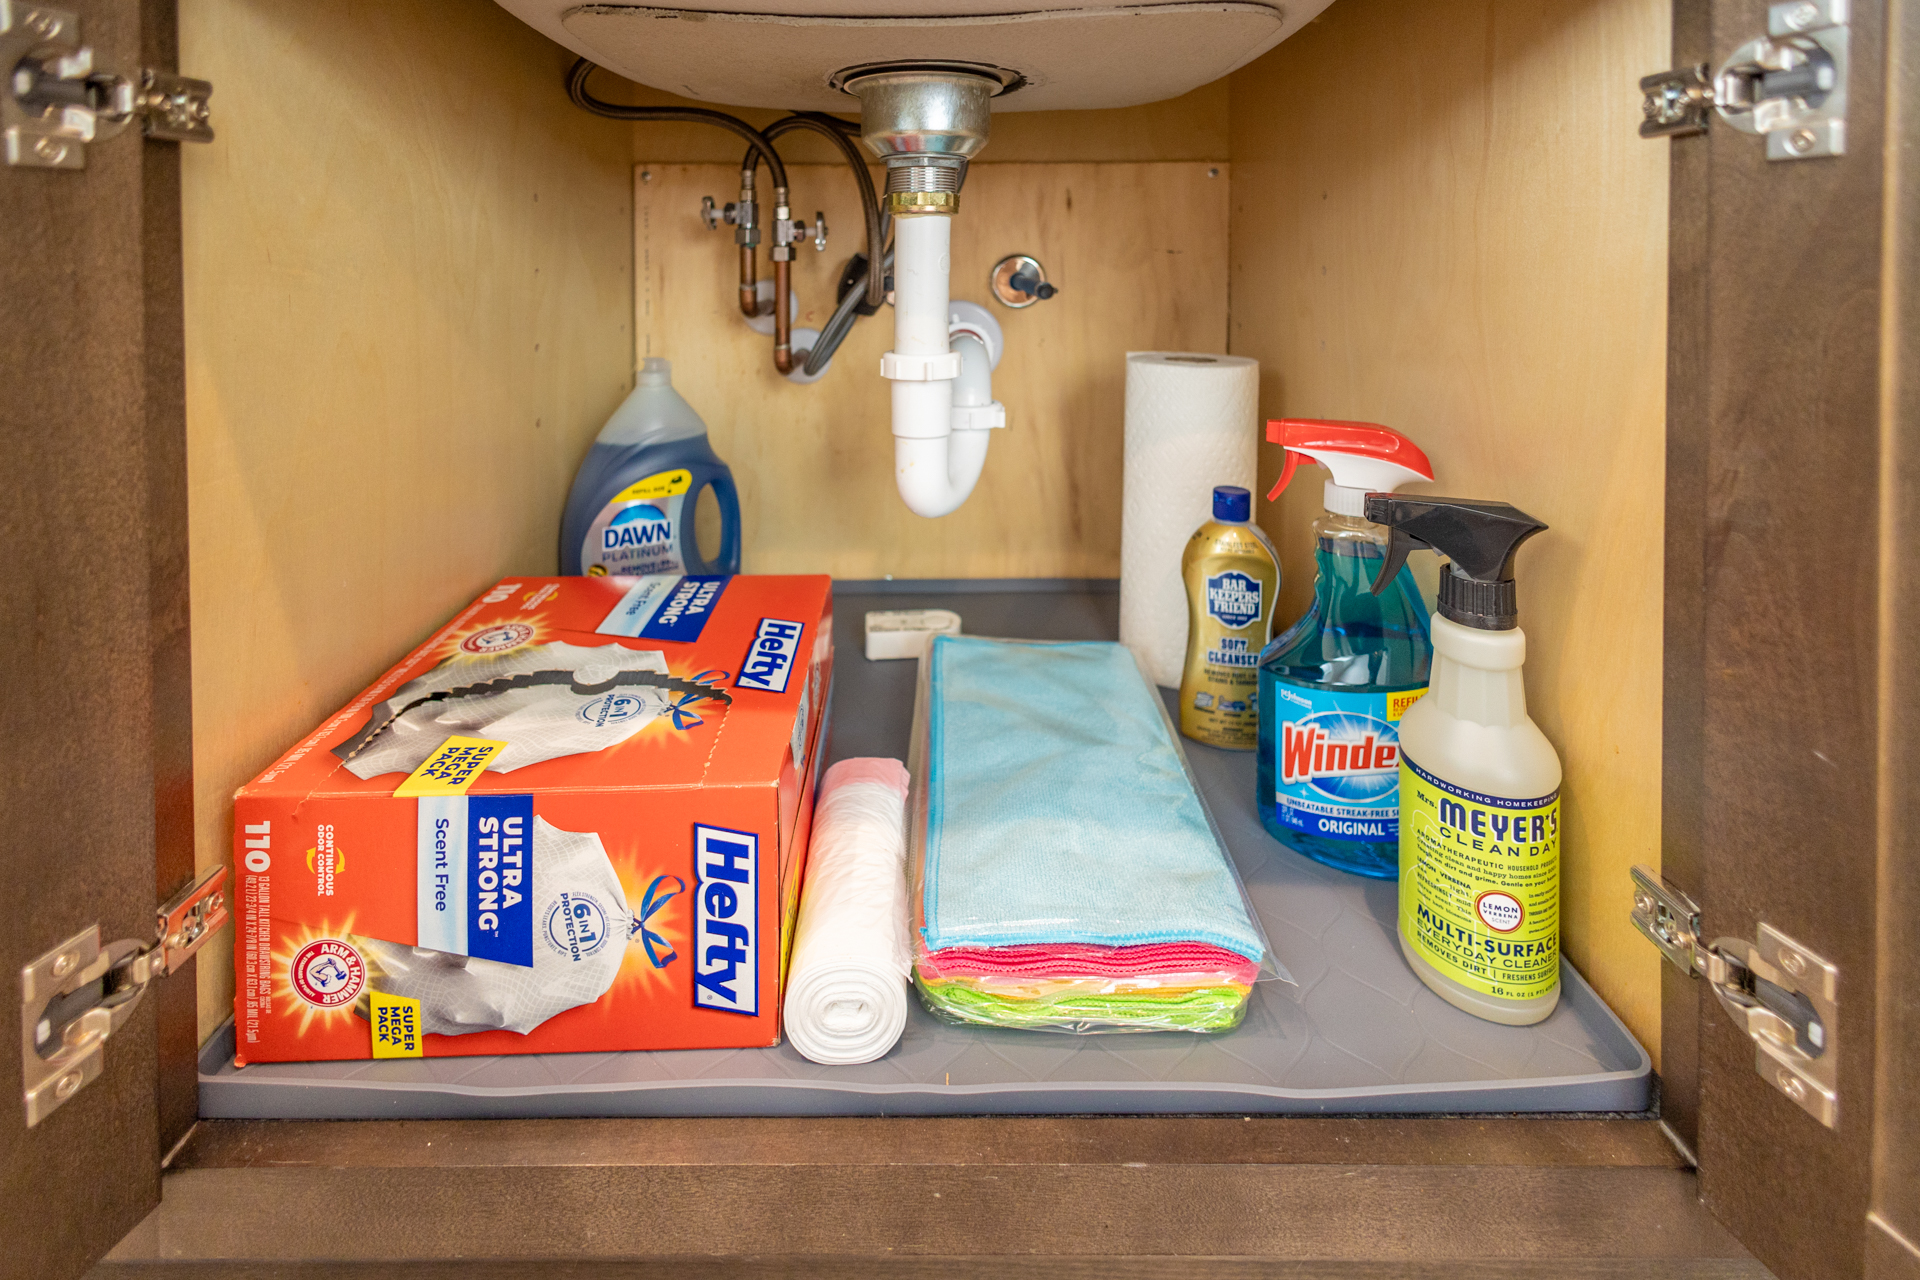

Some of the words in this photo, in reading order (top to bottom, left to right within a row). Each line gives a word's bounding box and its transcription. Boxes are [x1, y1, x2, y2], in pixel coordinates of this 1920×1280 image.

[605, 521, 670, 549] DAWN
[602, 544, 673, 562] PLATINUM
[685, 582, 720, 615] ULTRA
[1209, 587, 1259, 604] KEEPERS
[1222, 578, 1247, 591] BAR
[658, 582, 701, 625] STRONG
[1214, 600, 1256, 615] FRIEND
[739, 623, 797, 687] Hefty
[1221, 639, 1247, 651] SOFT
[595, 694, 615, 728] PROTECTION
[419, 747, 461, 777] PACK
[434, 747, 478, 780] MEGA
[447, 746, 494, 785] SUPER
[1285, 725, 1399, 779] Winde
[1416, 767, 1491, 803] HARDWORKING
[1497, 792, 1557, 807] HOMEKEEPING
[1286, 797, 1334, 815] UNBEATABLE
[1336, 808, 1390, 818] STREAK-FREE
[1416, 789, 1437, 809] Mrs.
[1438, 797, 1557, 844] MEYER'S
[317, 824, 325, 851] ODOR
[1318, 818, 1385, 836] ORIGINAL
[1440, 826, 1520, 857] CLEAN
[1530, 838, 1557, 857] DAY
[245, 820, 271, 872] 110
[435, 818, 449, 869] Scent
[1417, 828, 1504, 870] AROMATHERAPEUTIC
[1507, 864, 1539, 872] HOUSEHOLD
[317, 853, 325, 896] CONTROL
[325, 824, 334, 896] CONTINUOUS
[478, 817, 499, 931] STRONG
[502, 816, 523, 909] ULTRA
[1444, 862, 1457, 871] dirt
[1458, 869, 1472, 878] and
[1474, 875, 1498, 885] grime.
[1445, 855, 1464, 867] clean
[1466, 865, 1481, 873] and
[1483, 868, 1507, 879] happy
[259, 882, 270, 904] GALLON
[435, 873, 449, 912] Free
[1440, 871, 1471, 890] VERBENA
[259, 904, 270, 918] TALL
[573, 903, 591, 919] 6
[695, 837, 750, 1005] Hefty
[1483, 902, 1518, 913] LEMON
[1483, 909, 1518, 919] VERBENA
[1491, 917, 1510, 925] SCENT
[259, 918, 270, 942] KITCHEN
[560, 892, 582, 962] PROTECTION
[579, 920, 590, 933] IN
[579, 932, 597, 943] 1
[1417, 903, 1557, 957] MULTI-SURFACE
[321, 943, 350, 959] ARM
[1417, 917, 1497, 964] EVERYDAY
[1503, 948, 1557, 969] CLEANER
[1417, 930, 1458, 963] REMOVES
[1462, 960, 1487, 975] DIRT
[259, 942, 271, 979] DRAWSTRING
[345, 956, 357, 967] &
[259, 979, 271, 995] BAGS
[322, 966, 361, 1003] HAMMER
[1491, 986, 1504, 995] 16
[1502, 972, 1536, 981] FRESHENS
[246, 1009, 258, 1018] MIL
[377, 1006, 390, 1042] PACK
[390, 1006, 402, 1046] MEGA
[402, 1005, 415, 1051] SUPER
